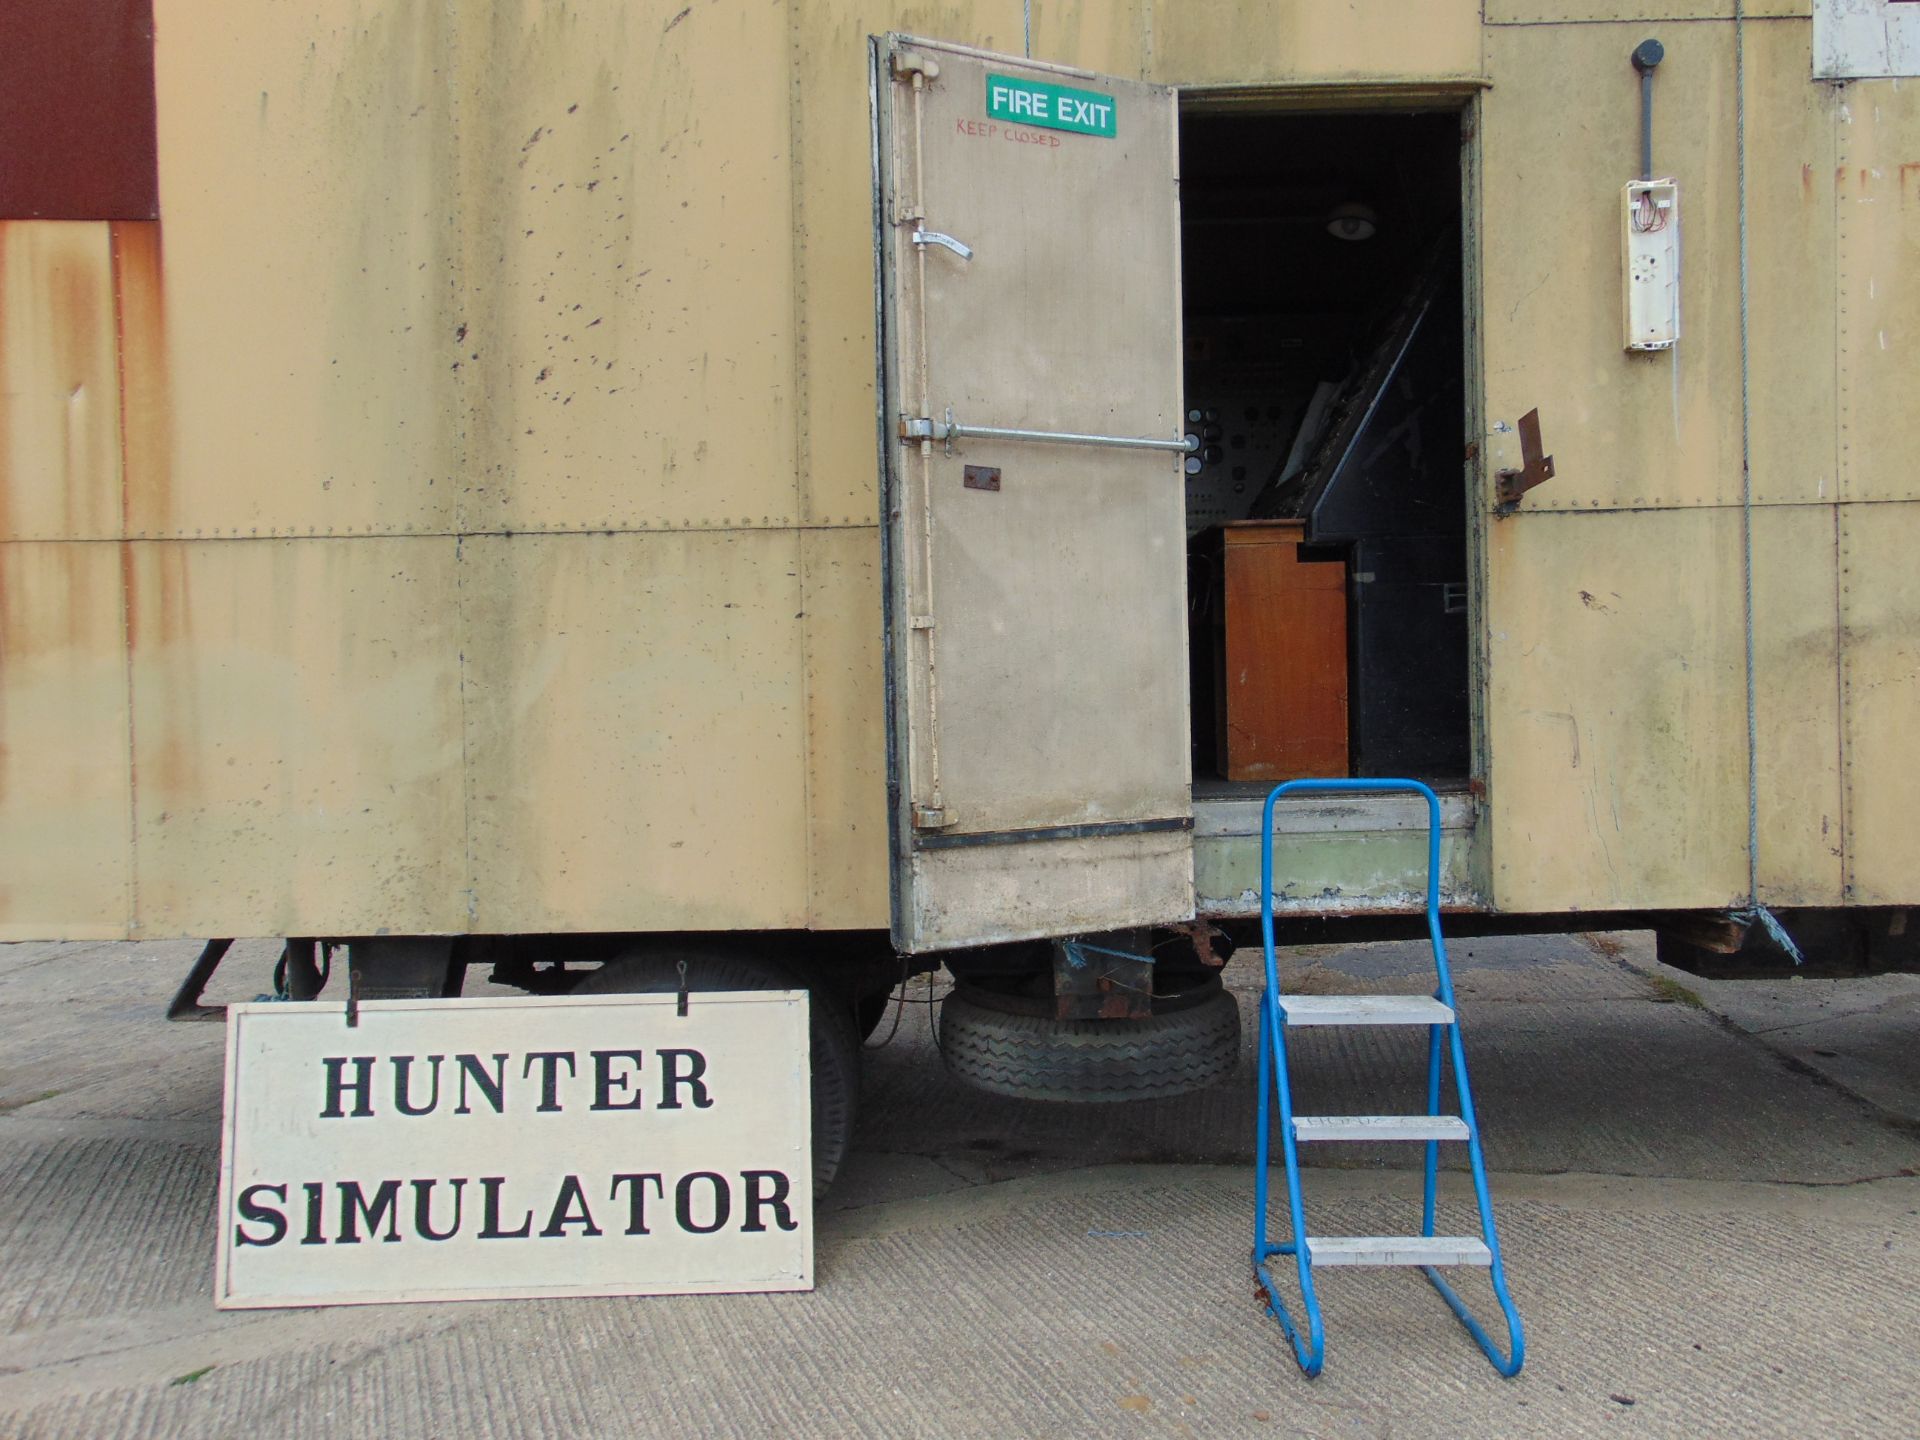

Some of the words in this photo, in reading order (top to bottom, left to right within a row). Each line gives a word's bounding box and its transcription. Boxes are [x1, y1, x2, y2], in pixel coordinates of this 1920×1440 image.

[956, 118, 998, 138] KEEP
[1004, 128, 1061, 147] CLOSED
[993, 86, 1048, 118] FIRE
[1058, 97, 1111, 129] EXIT
[320, 1049, 714, 1118] HUNTER
[235, 1170, 799, 1247] SIMULATOR
